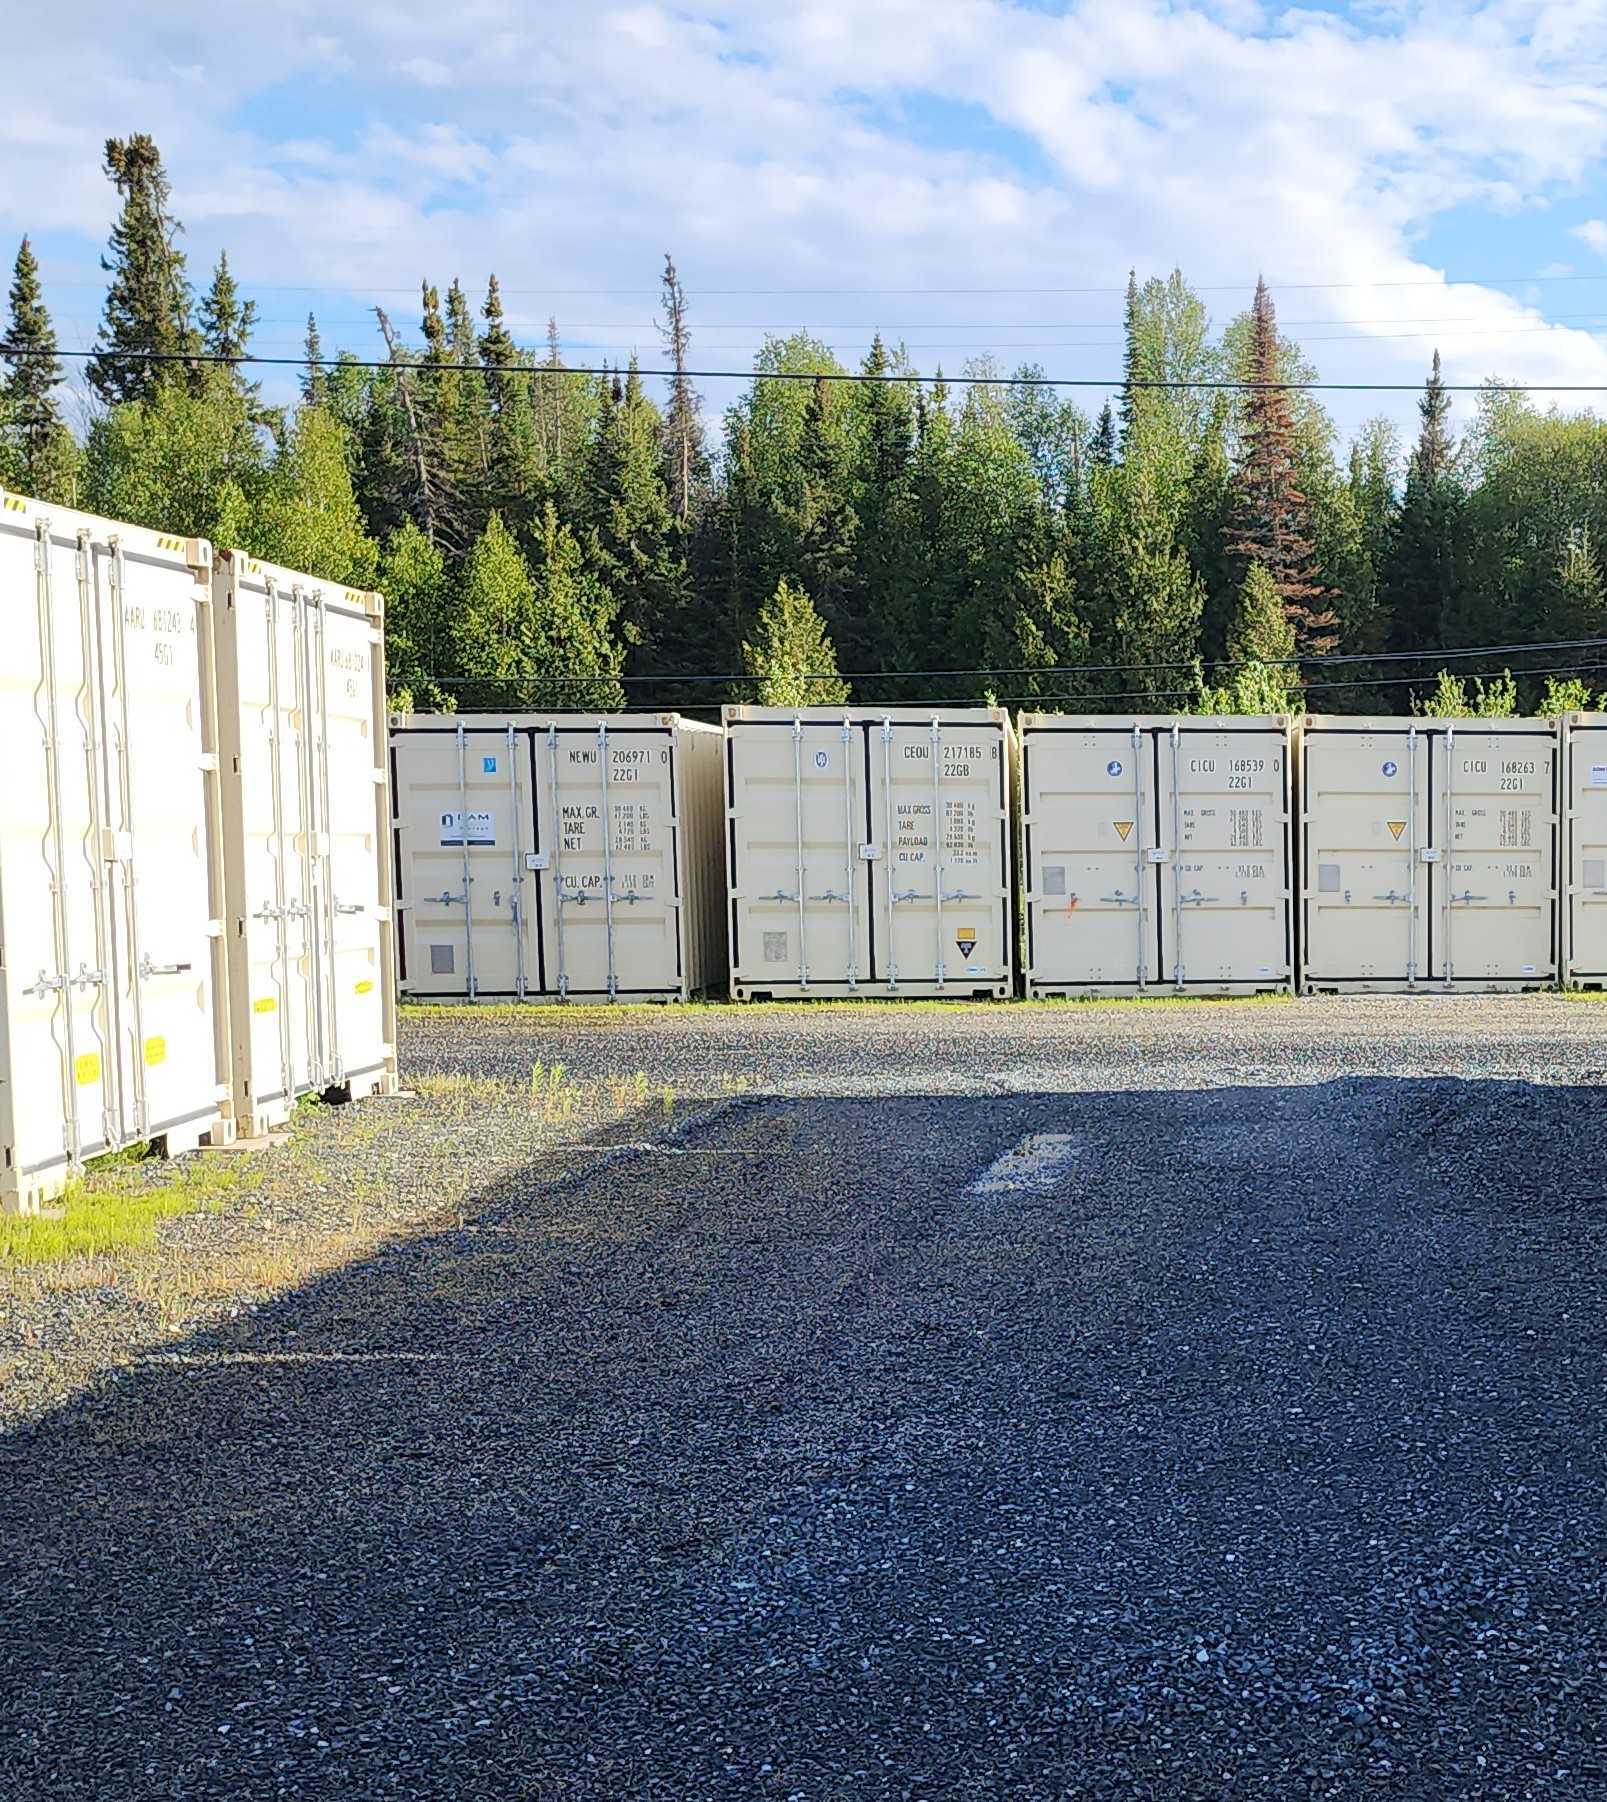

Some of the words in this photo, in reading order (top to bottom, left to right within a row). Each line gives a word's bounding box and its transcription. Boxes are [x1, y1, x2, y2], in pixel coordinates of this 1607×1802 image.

[569, 750, 597, 763] NEWU
[612, 750, 650, 763] 206971
[661, 751, 667, 763] 0
[904, 746, 929, 759] CEOU
[943, 746, 981, 759] 217185
[991, 746, 997, 759] 8
[1190, 759, 1215, 772] CICU
[1229, 759, 1264, 772] 168539
[1273, 759, 1280, 772] 0
[1463, 760, 1487, 773] CICU
[1501, 761, 1535, 774] 168263
[1543, 761, 1550, 774] 7
[613, 768, 638, 781] 22G1
[1228, 776, 1253, 788] 22G1
[1500, 778, 1523, 790] 22G1
[563, 821, 585, 835] TARE
[564, 837, 582, 850] NET
[898, 836, 928, 847] PAYLOAD
